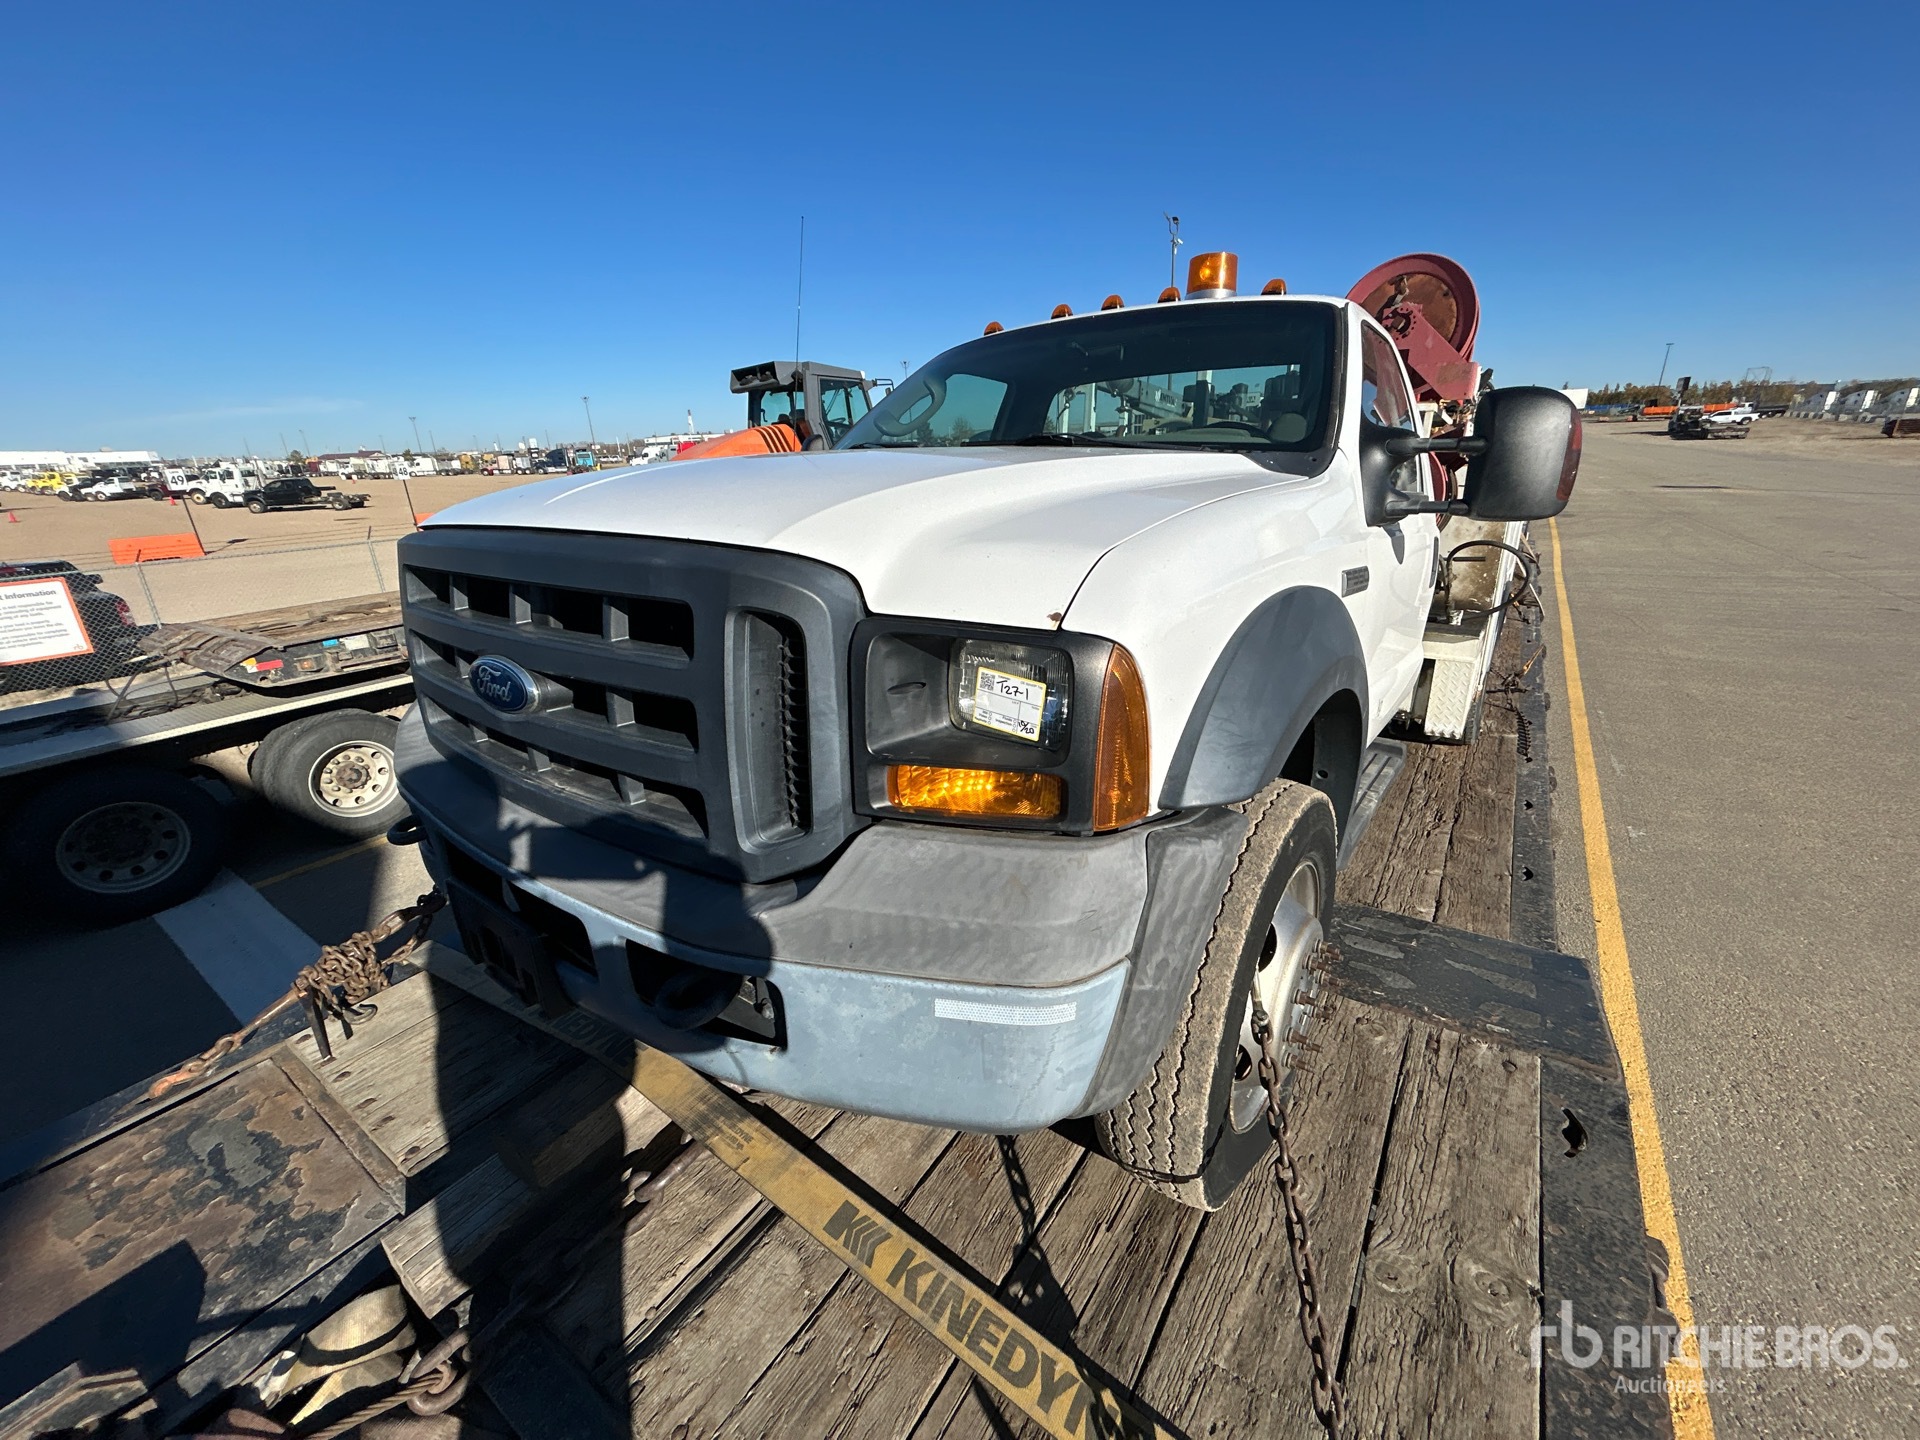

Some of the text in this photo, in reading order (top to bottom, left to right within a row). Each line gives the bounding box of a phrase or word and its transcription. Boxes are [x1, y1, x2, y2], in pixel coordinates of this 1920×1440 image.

[170, 475, 185, 486] 49
[4, 590, 57, 600] Information
[477, 665, 512, 702] Ford
[996, 680, 1029, 700] T27-1
[886, 1248, 1146, 1440] KINEDYN
